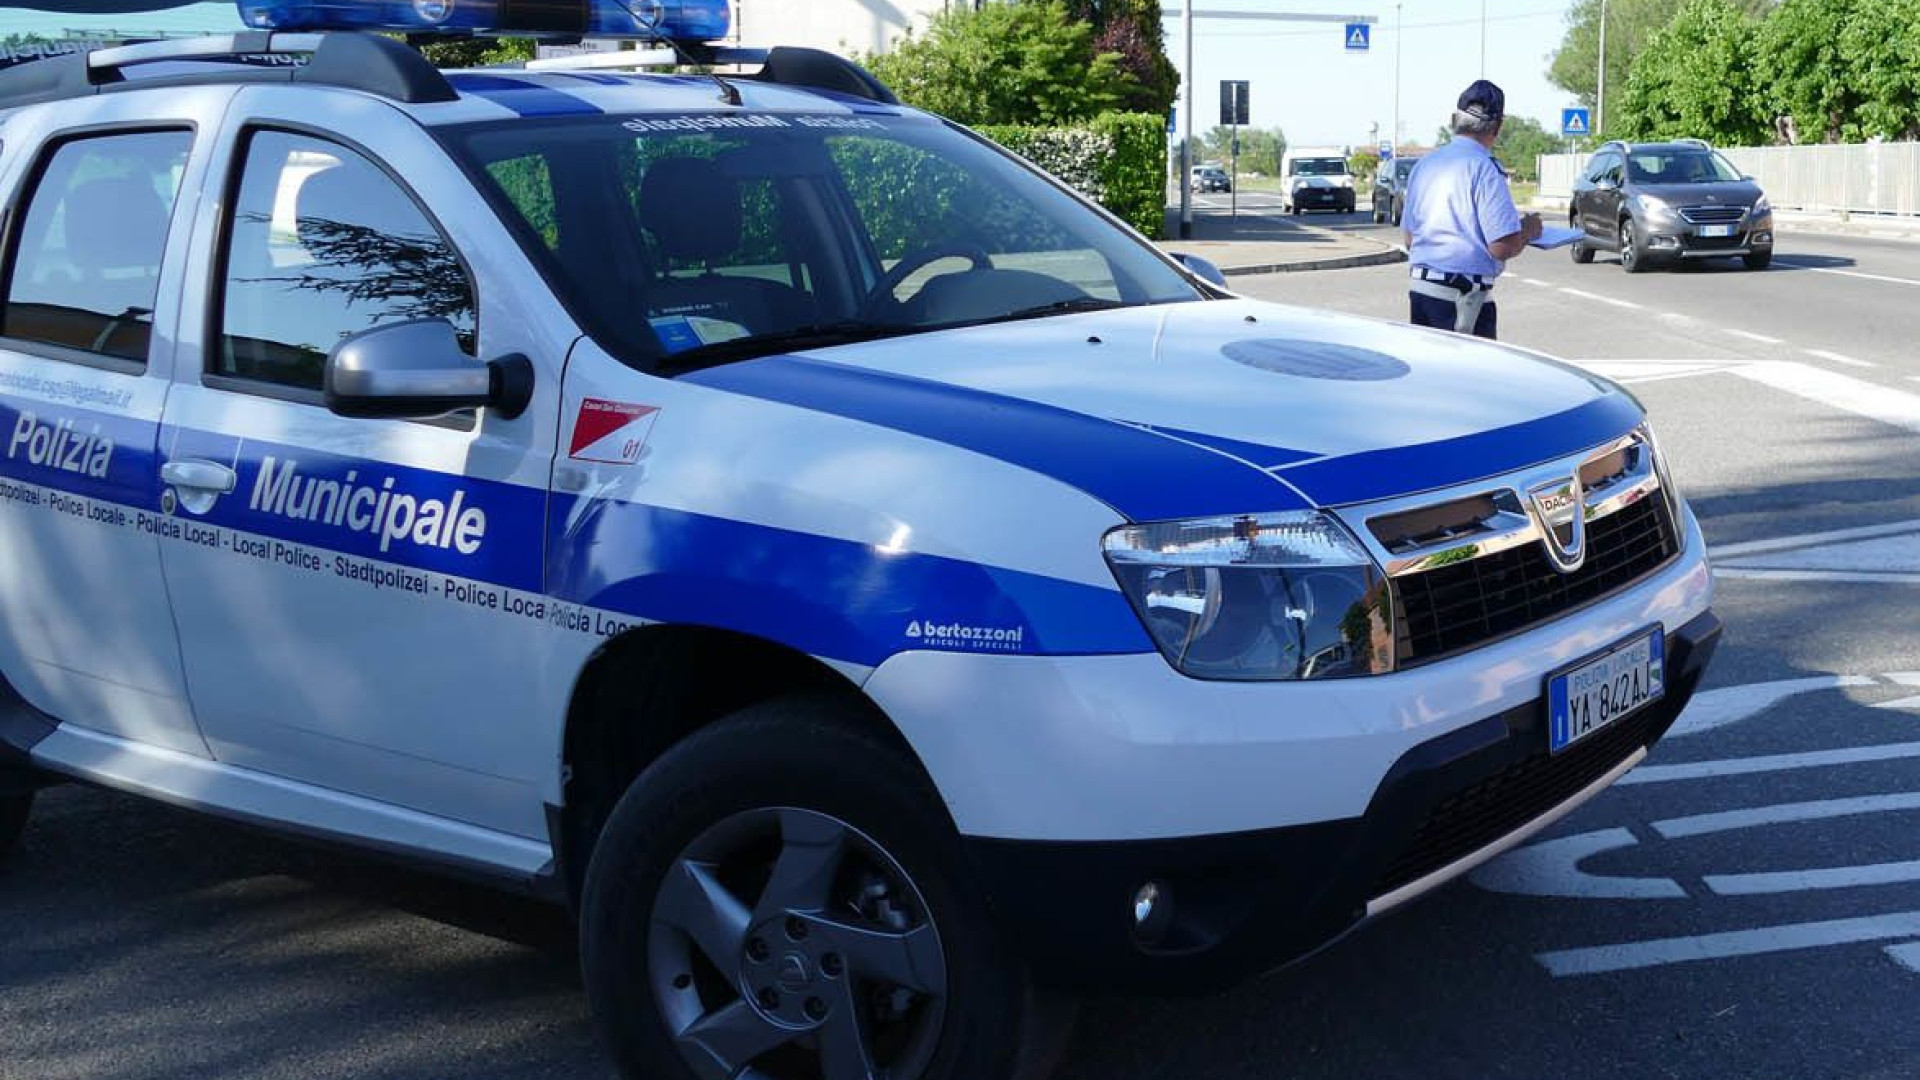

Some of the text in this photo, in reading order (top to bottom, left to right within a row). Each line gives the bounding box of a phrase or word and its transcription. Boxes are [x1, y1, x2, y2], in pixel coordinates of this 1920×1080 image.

[7, 408, 487, 555] Polizia Municipale
[622, 438, 641, 459] 01
[49, 491, 84, 516] Police
[87, 502, 126, 526] Locale
[184, 522, 220, 548] Local
[233, 532, 271, 559] Local
[275, 542, 320, 571] Police
[334, 555, 428, 594] Stadtpolizei
[444, 578, 498, 608] Police
[924, 620, 1022, 641] bertazzoni
[1570, 693, 1591, 736] YA
[1600, 660, 1650, 721] 842AJ
